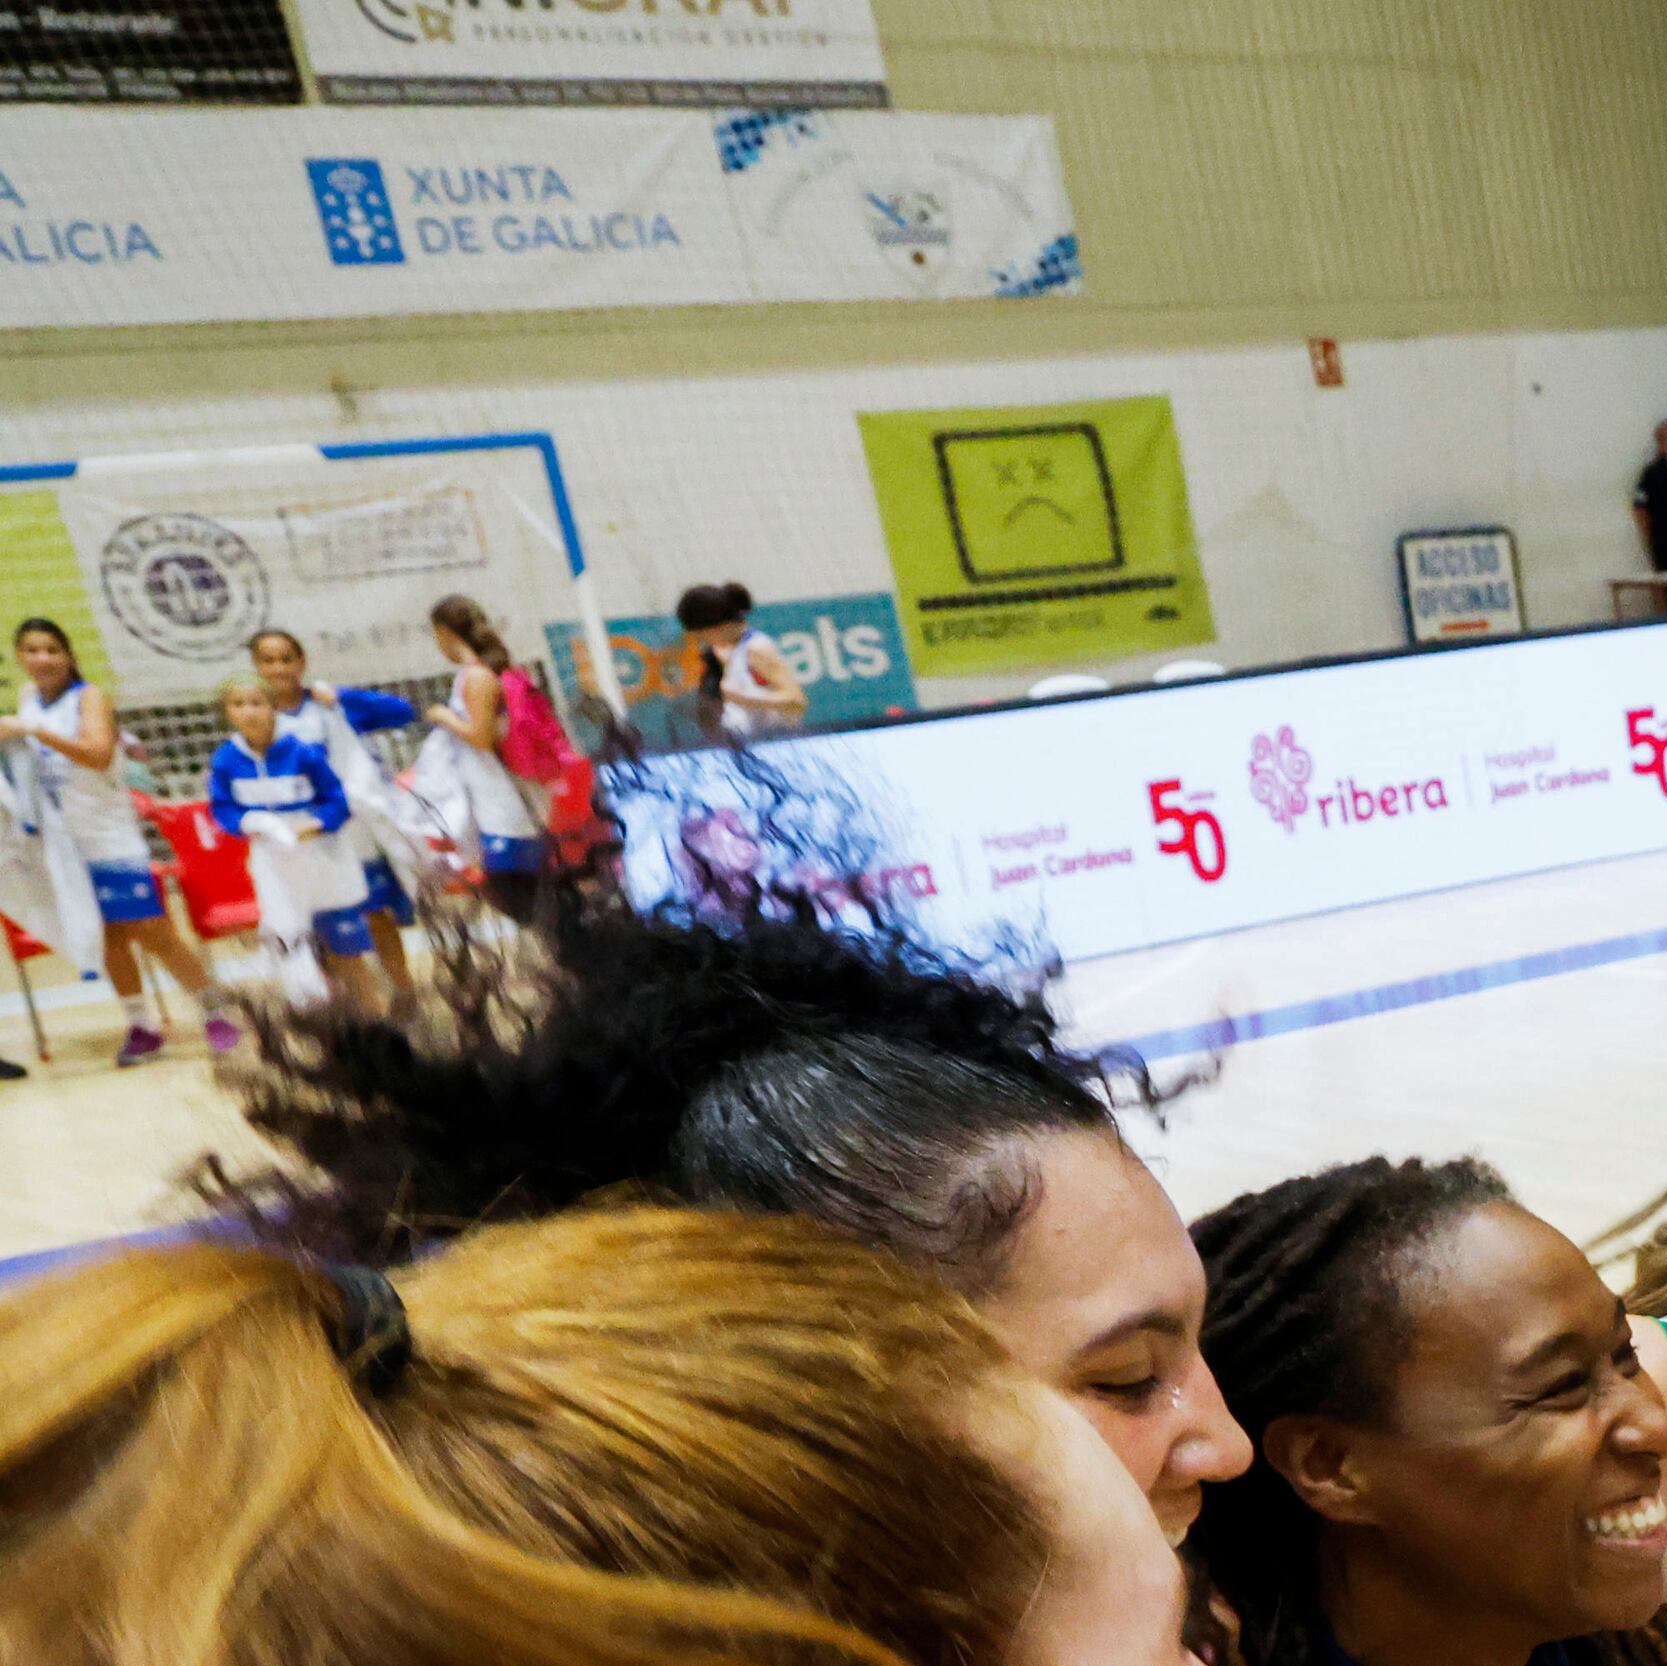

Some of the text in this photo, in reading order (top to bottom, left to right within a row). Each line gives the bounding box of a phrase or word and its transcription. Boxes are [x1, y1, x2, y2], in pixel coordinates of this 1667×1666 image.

[407, 166, 574, 203] XUNTA
[417, 211, 682, 255] DE GALICIA
[1317, 776, 1449, 828] ribera
[1490, 777, 1530, 805] Juan
[981, 821, 1068, 851] Hospital
[1147, 778, 1226, 883] 50
[989, 847, 1134, 892] Juan Cardona
